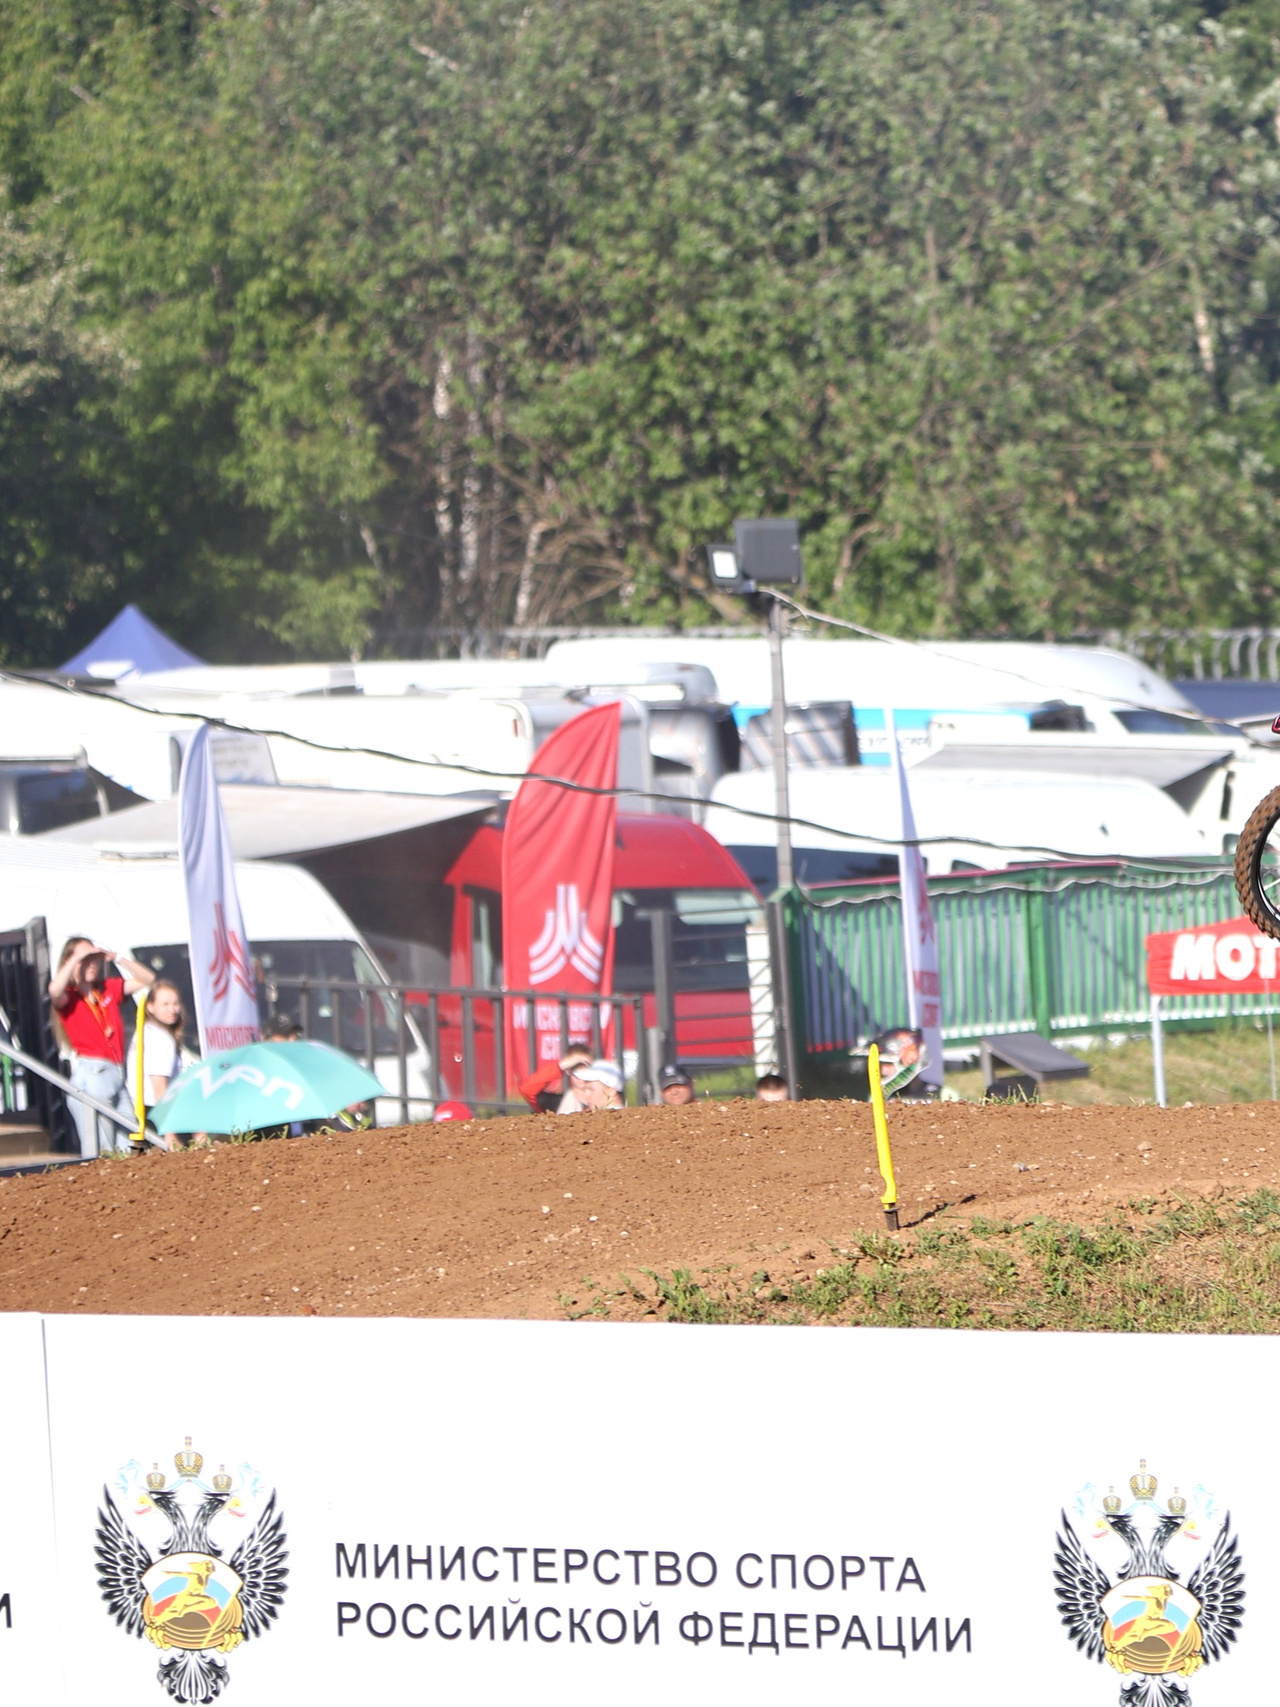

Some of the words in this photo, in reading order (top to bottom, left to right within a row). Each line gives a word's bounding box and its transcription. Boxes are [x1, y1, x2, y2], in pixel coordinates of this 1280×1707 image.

[336, 1542, 718, 1588] МИНИСТЕРСТВО
[735, 1552, 926, 1593] СПОРТА
[337, 1597, 660, 1645] РОССИЙСКОЙ
[678, 1611, 972, 1659] ФЕДЕРАЦИИ
